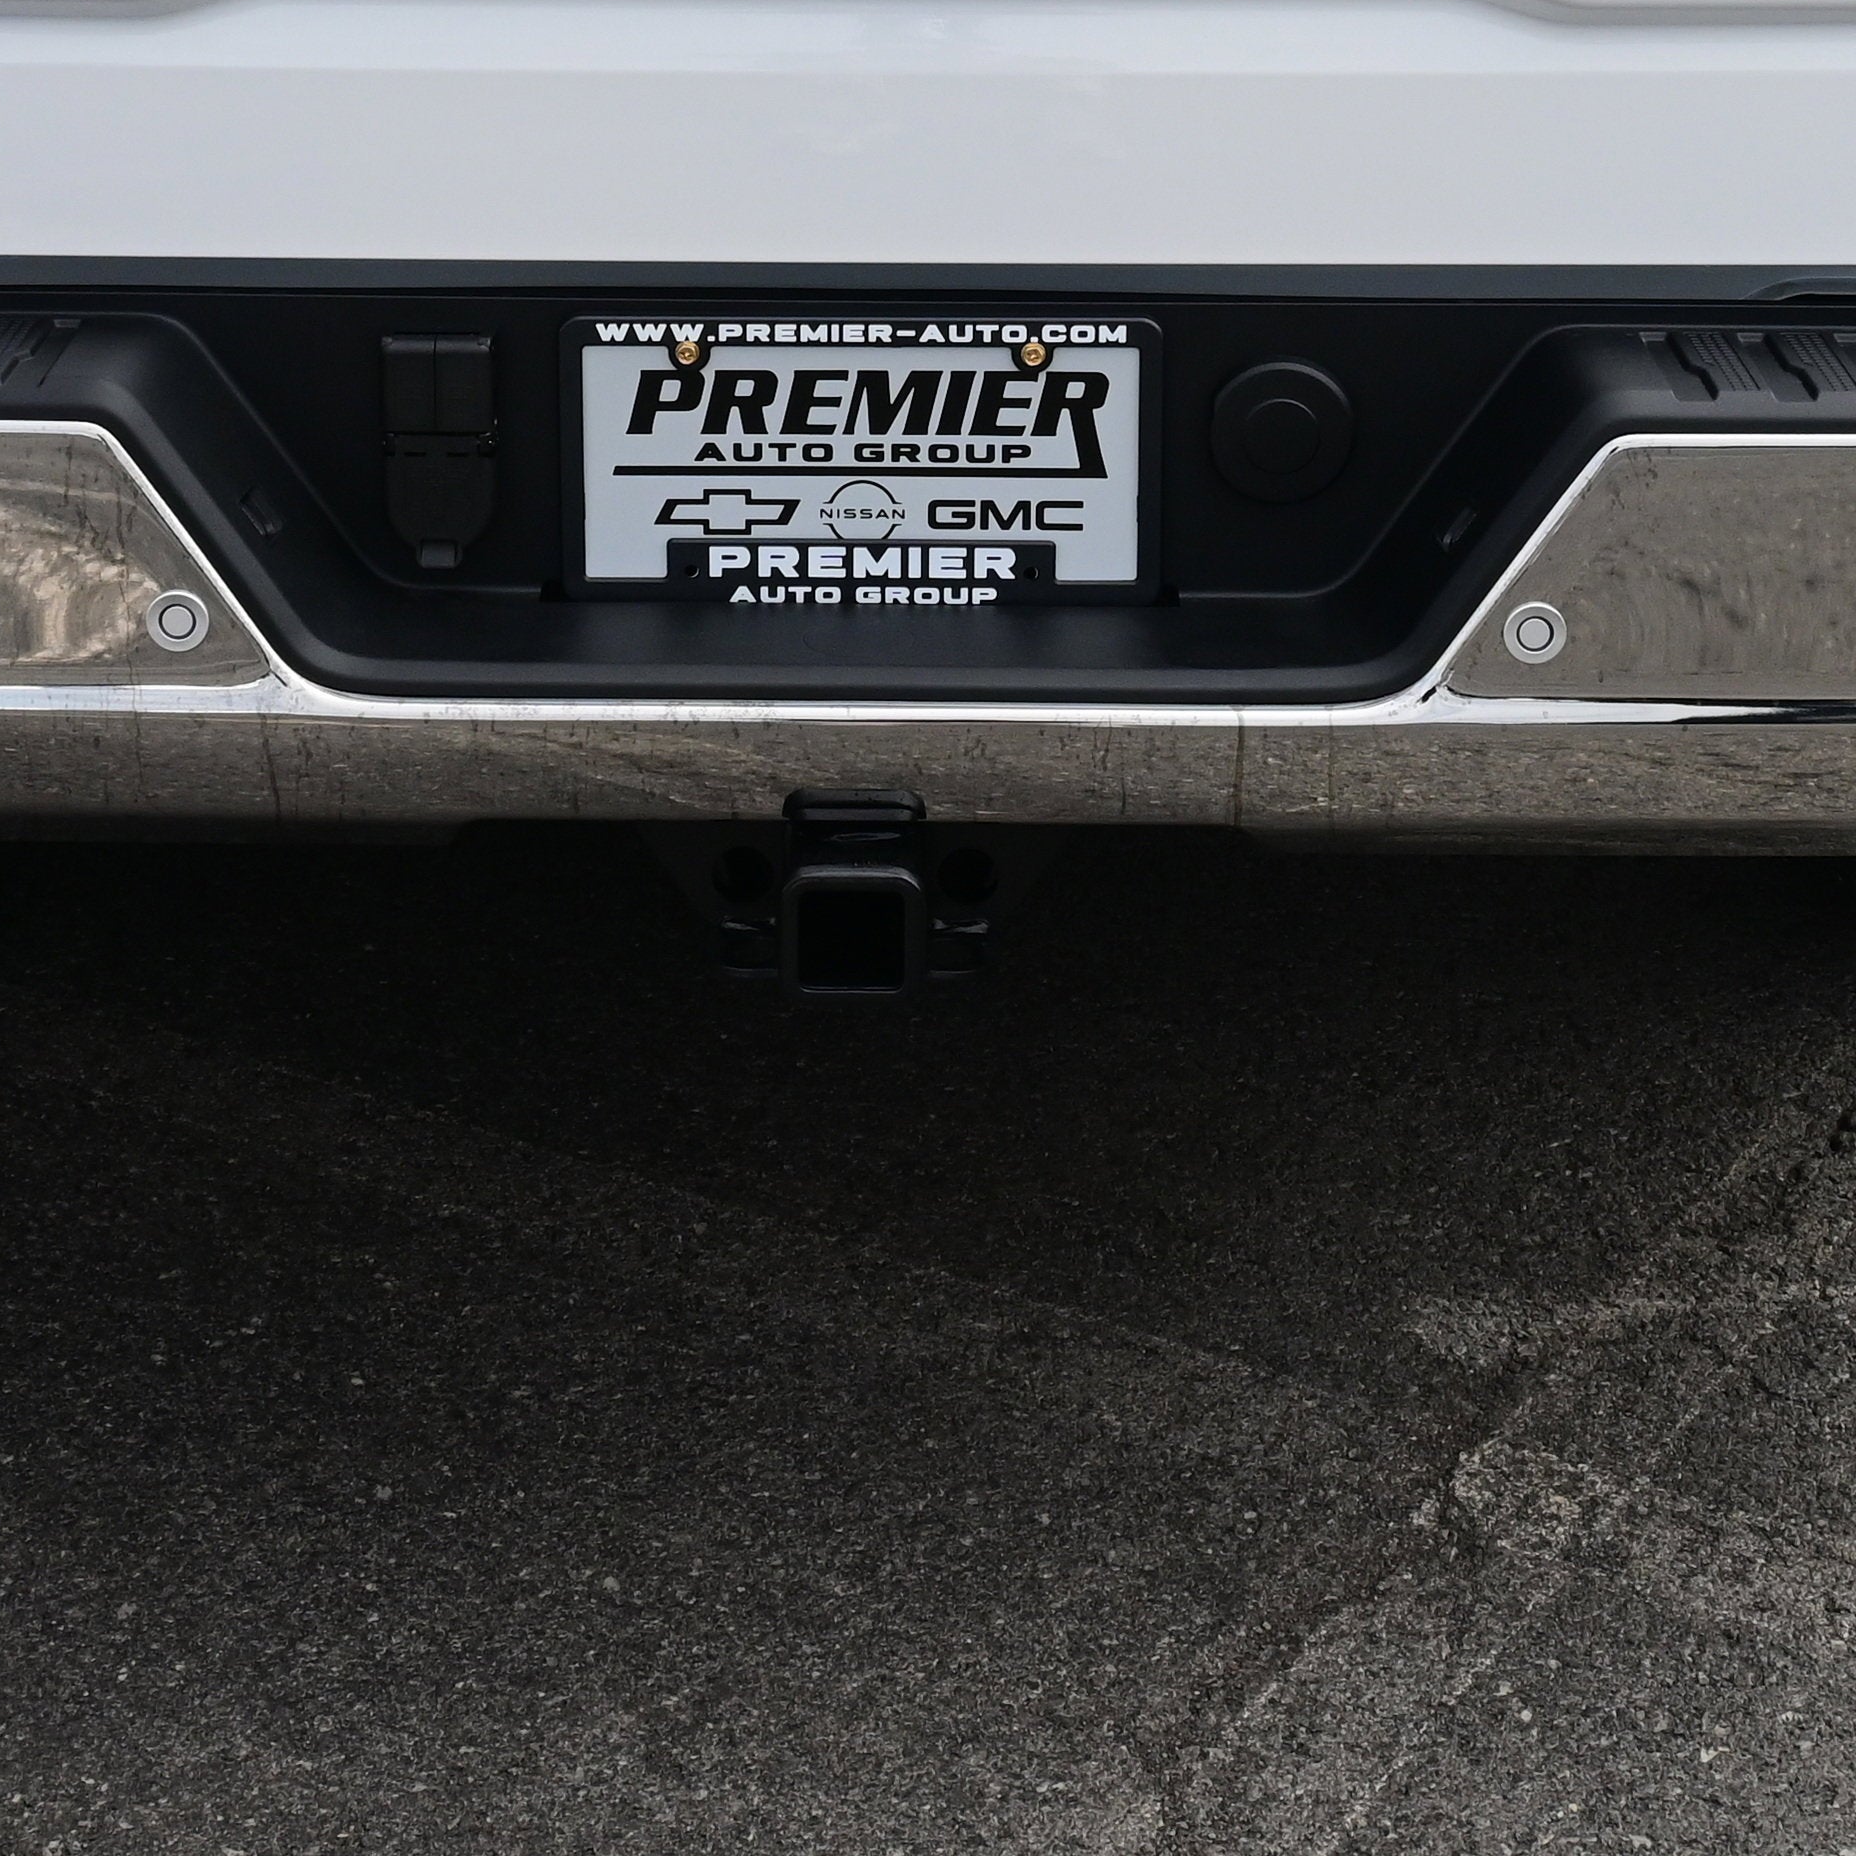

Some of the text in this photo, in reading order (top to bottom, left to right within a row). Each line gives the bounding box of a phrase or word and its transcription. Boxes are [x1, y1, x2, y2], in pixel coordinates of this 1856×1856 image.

[595, 323, 1127, 344] WWW.PREMIER-AUTO.COM
[626, 369, 1110, 478] PREMIER
[694, 442, 1032, 464] AUTO GROUP
[819, 508, 906, 520] NISSAN
[927, 499, 1085, 531] GMC
[709, 546, 1016, 580] PREMIER
[729, 585, 998, 605] AUTO GROUP
